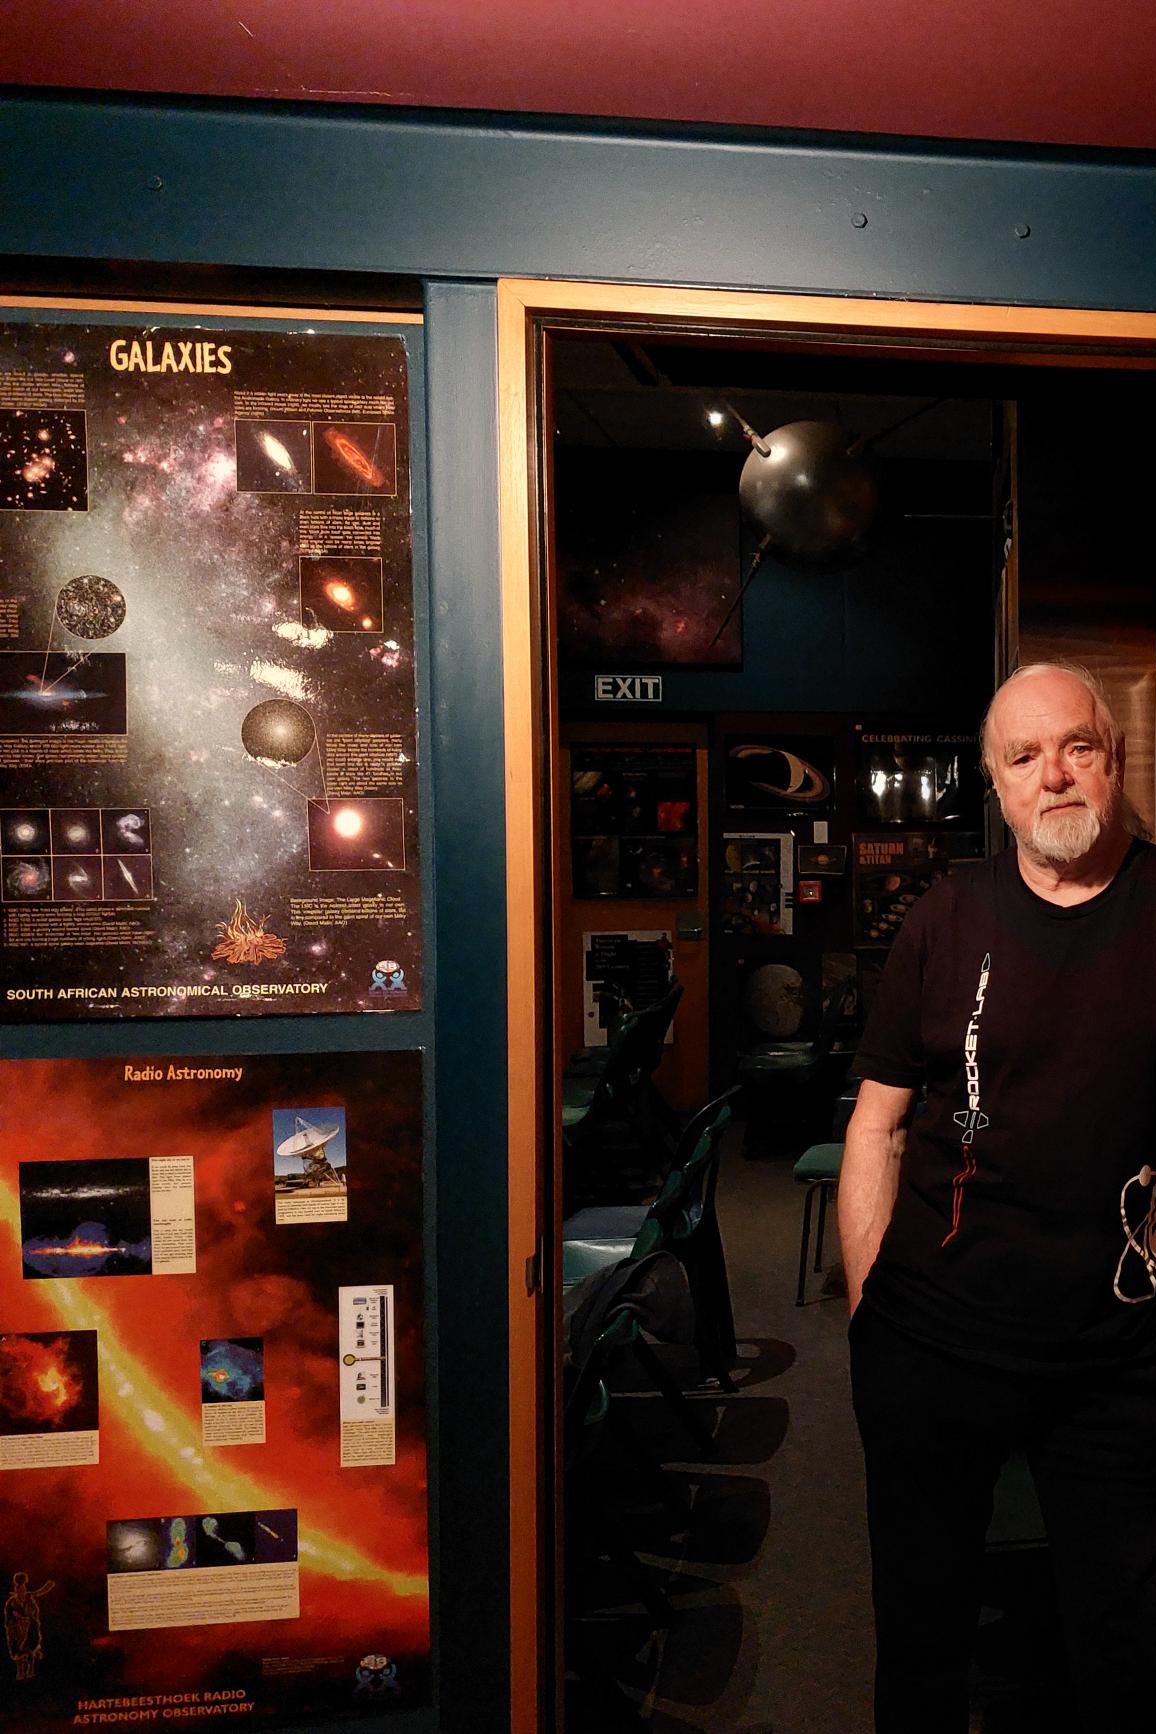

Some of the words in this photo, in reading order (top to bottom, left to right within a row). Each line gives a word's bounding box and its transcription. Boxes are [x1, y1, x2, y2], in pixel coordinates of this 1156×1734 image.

[109, 339, 233, 375] GALAXIES
[597, 678, 659, 700] EXIT
[861, 734, 932, 744] CELEBRATING
[936, 734, 977, 744] CASSINI
[857, 842, 905, 855] SATURN
[6, 988, 55, 1001] SOUTH
[57, 986, 118, 999] AFRICAN
[121, 984, 229, 998] ASTRONOMICAL
[232, 983, 328, 996] OBSERVATORY
[972, 971, 990, 1016] LAB
[124, 1065, 163, 1082] Radio
[166, 1064, 243, 1083] Astronomy
[965, 1020, 980, 1111] ROCKET
[77, 1691, 200, 1710] HARTEBEESTHOEK
[203, 1688, 246, 1702] RADIO
[73, 1709, 159, 1725] ASTRONOMY
[162, 1701, 255, 1720] OBSERVATORY
